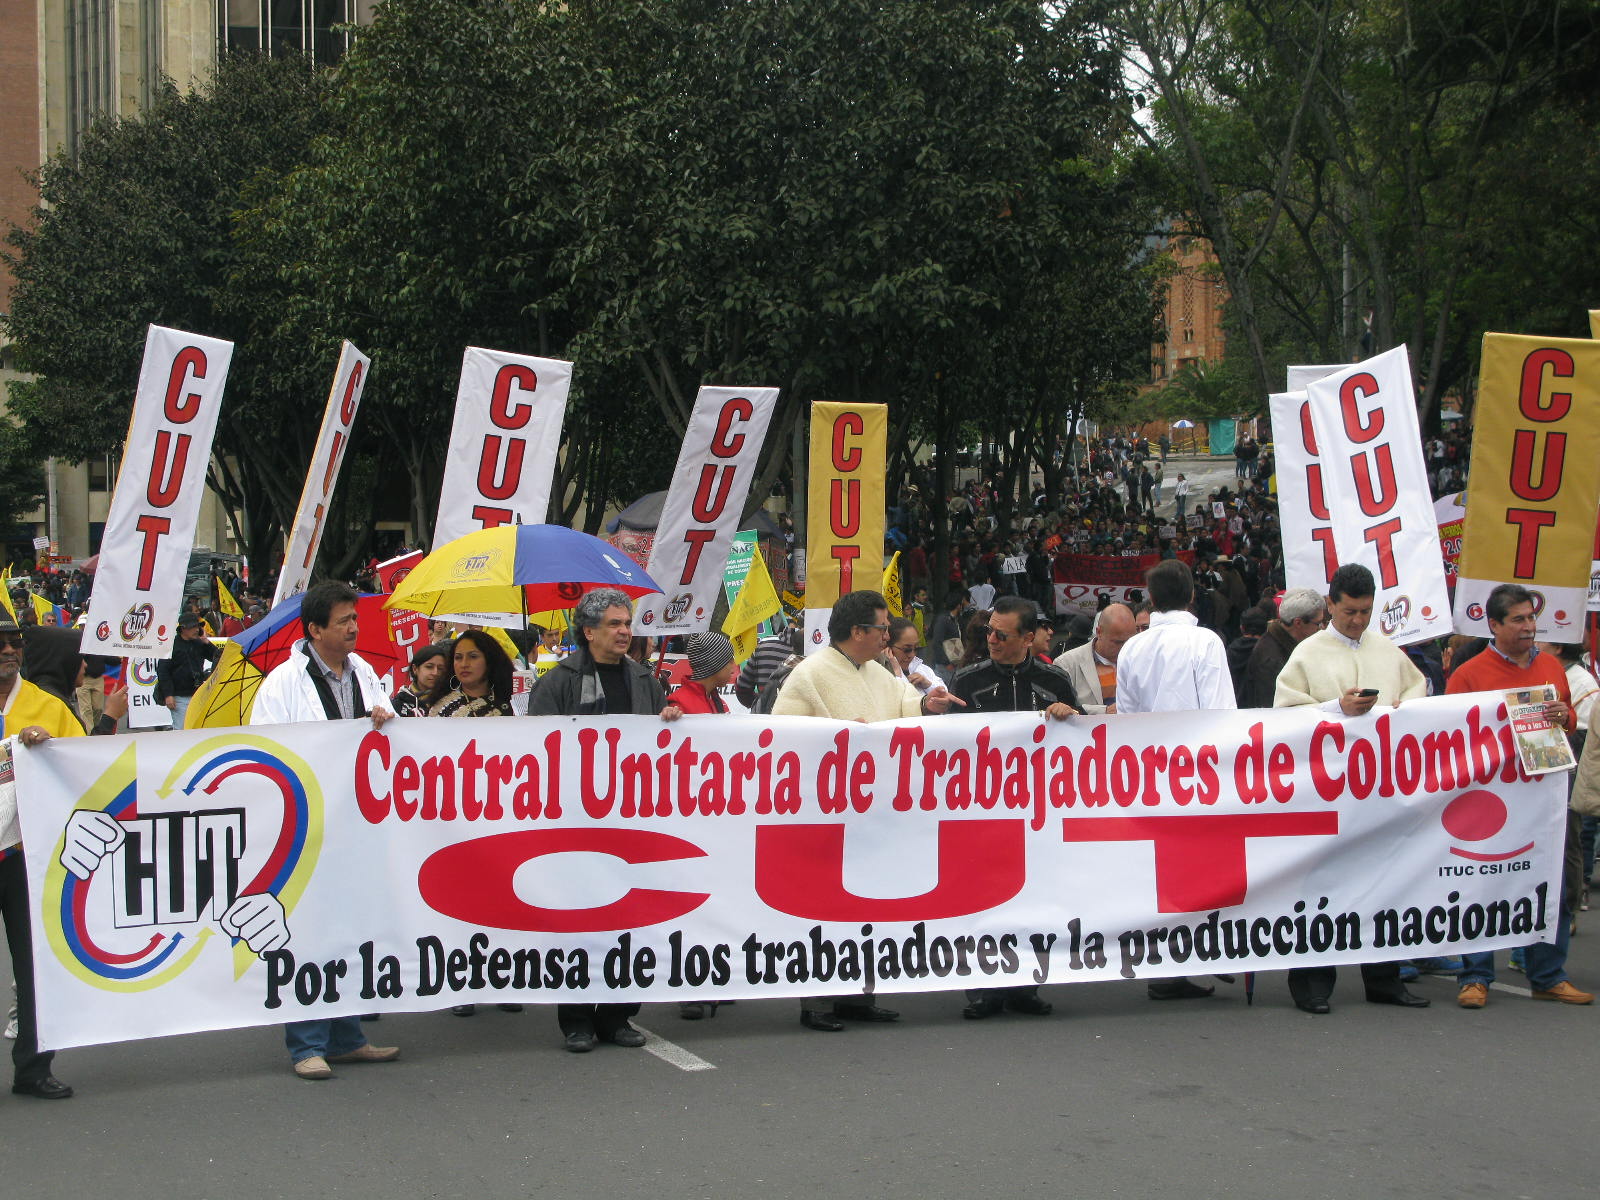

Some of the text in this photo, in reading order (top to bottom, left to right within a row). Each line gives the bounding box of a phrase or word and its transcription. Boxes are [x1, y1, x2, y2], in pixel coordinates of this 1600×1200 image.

[135, 346, 208, 591] CUT
[303, 359, 363, 569] CUT
[680, 397, 753, 586] CUT
[829, 411, 864, 598] CUT
[1338, 372, 1402, 590] CUT
[1505, 347, 1575, 580] CUT
[390, 612, 421, 627] RESENT
[133, 694, 151, 706] EN
[355, 704, 1544, 832] Central Unitaria de Trabajadores de Colombi
[264, 881, 1548, 1010] Por la Defensa de los trabajadores y la producción nacional
[418, 810, 1339, 931] CUT
[1439, 860, 1531, 876] ITUC CSI IGB
